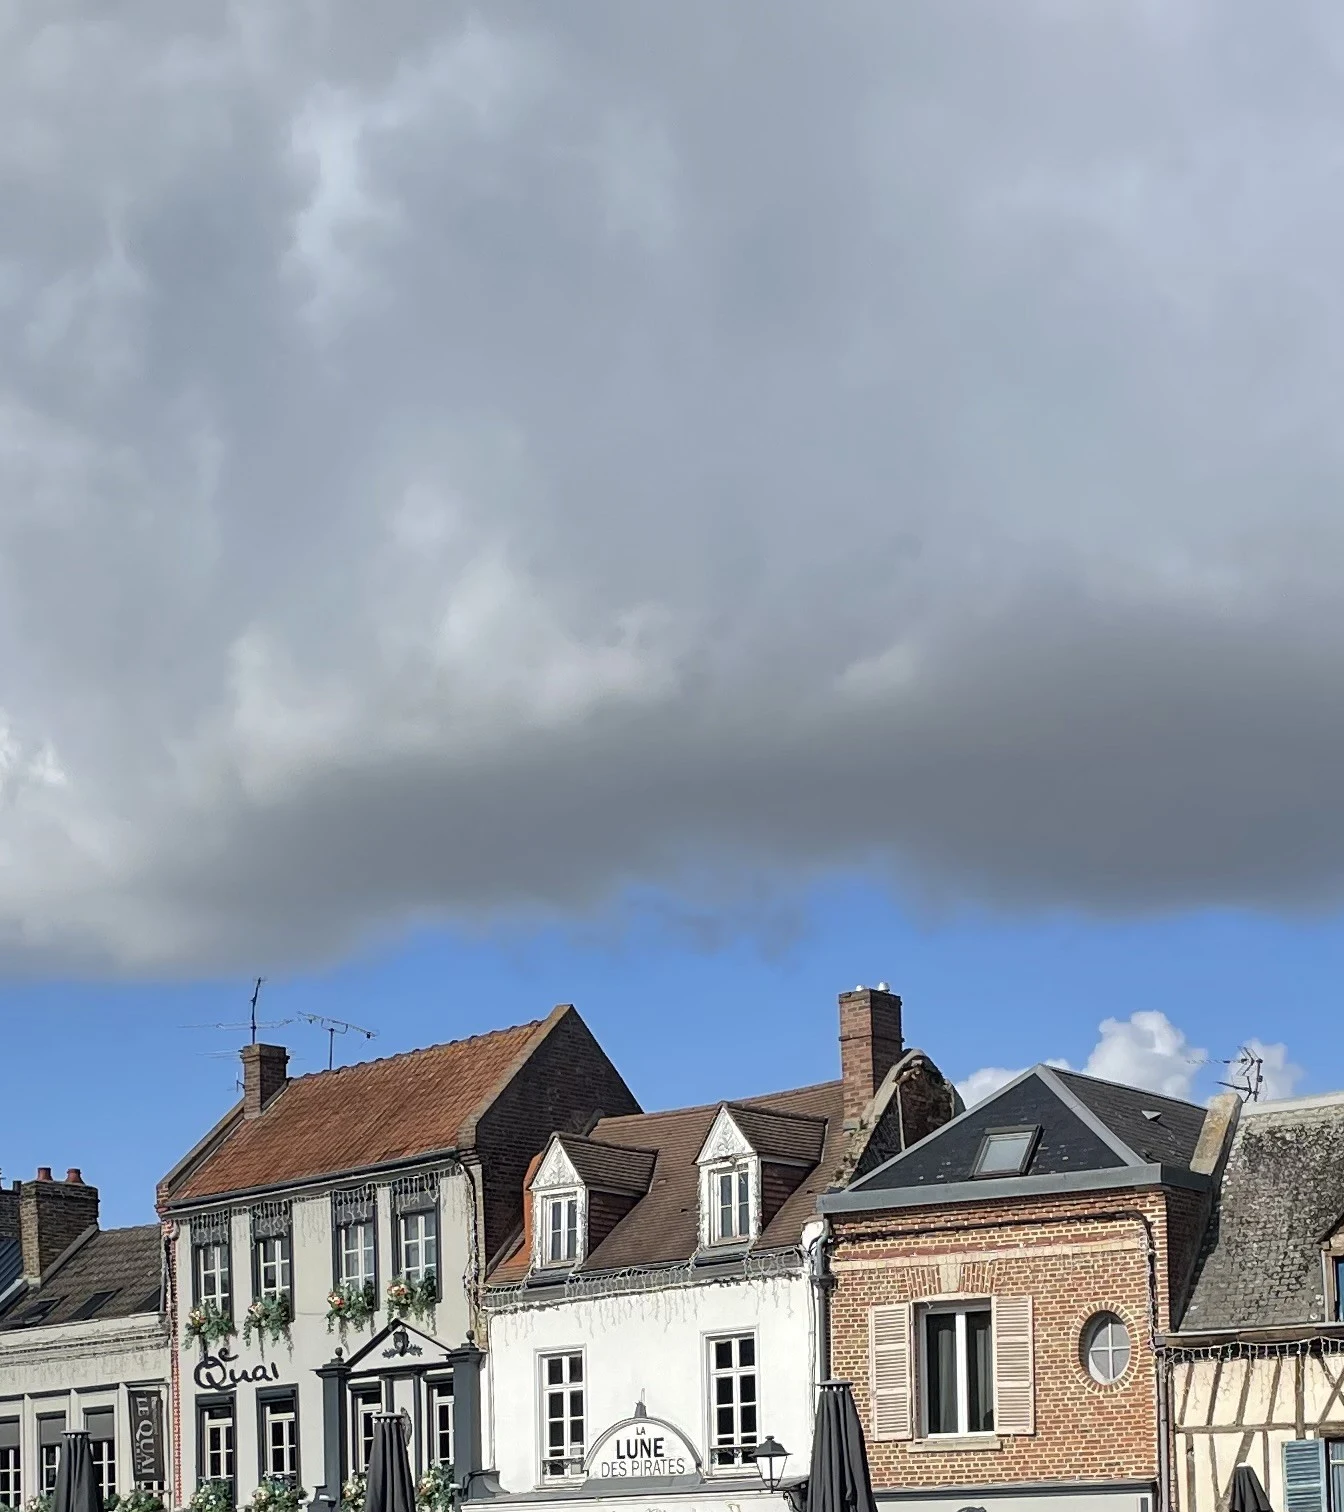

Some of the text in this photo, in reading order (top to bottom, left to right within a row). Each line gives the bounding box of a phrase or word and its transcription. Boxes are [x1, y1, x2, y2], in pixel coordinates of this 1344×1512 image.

[194, 1356, 280, 1391] Quai
[136, 1397, 155, 1474] LE QUAI
[636, 1427, 646, 1436] LA
[616, 1437, 665, 1460] LUNE
[601, 1458, 685, 1478] DES PIRATES
